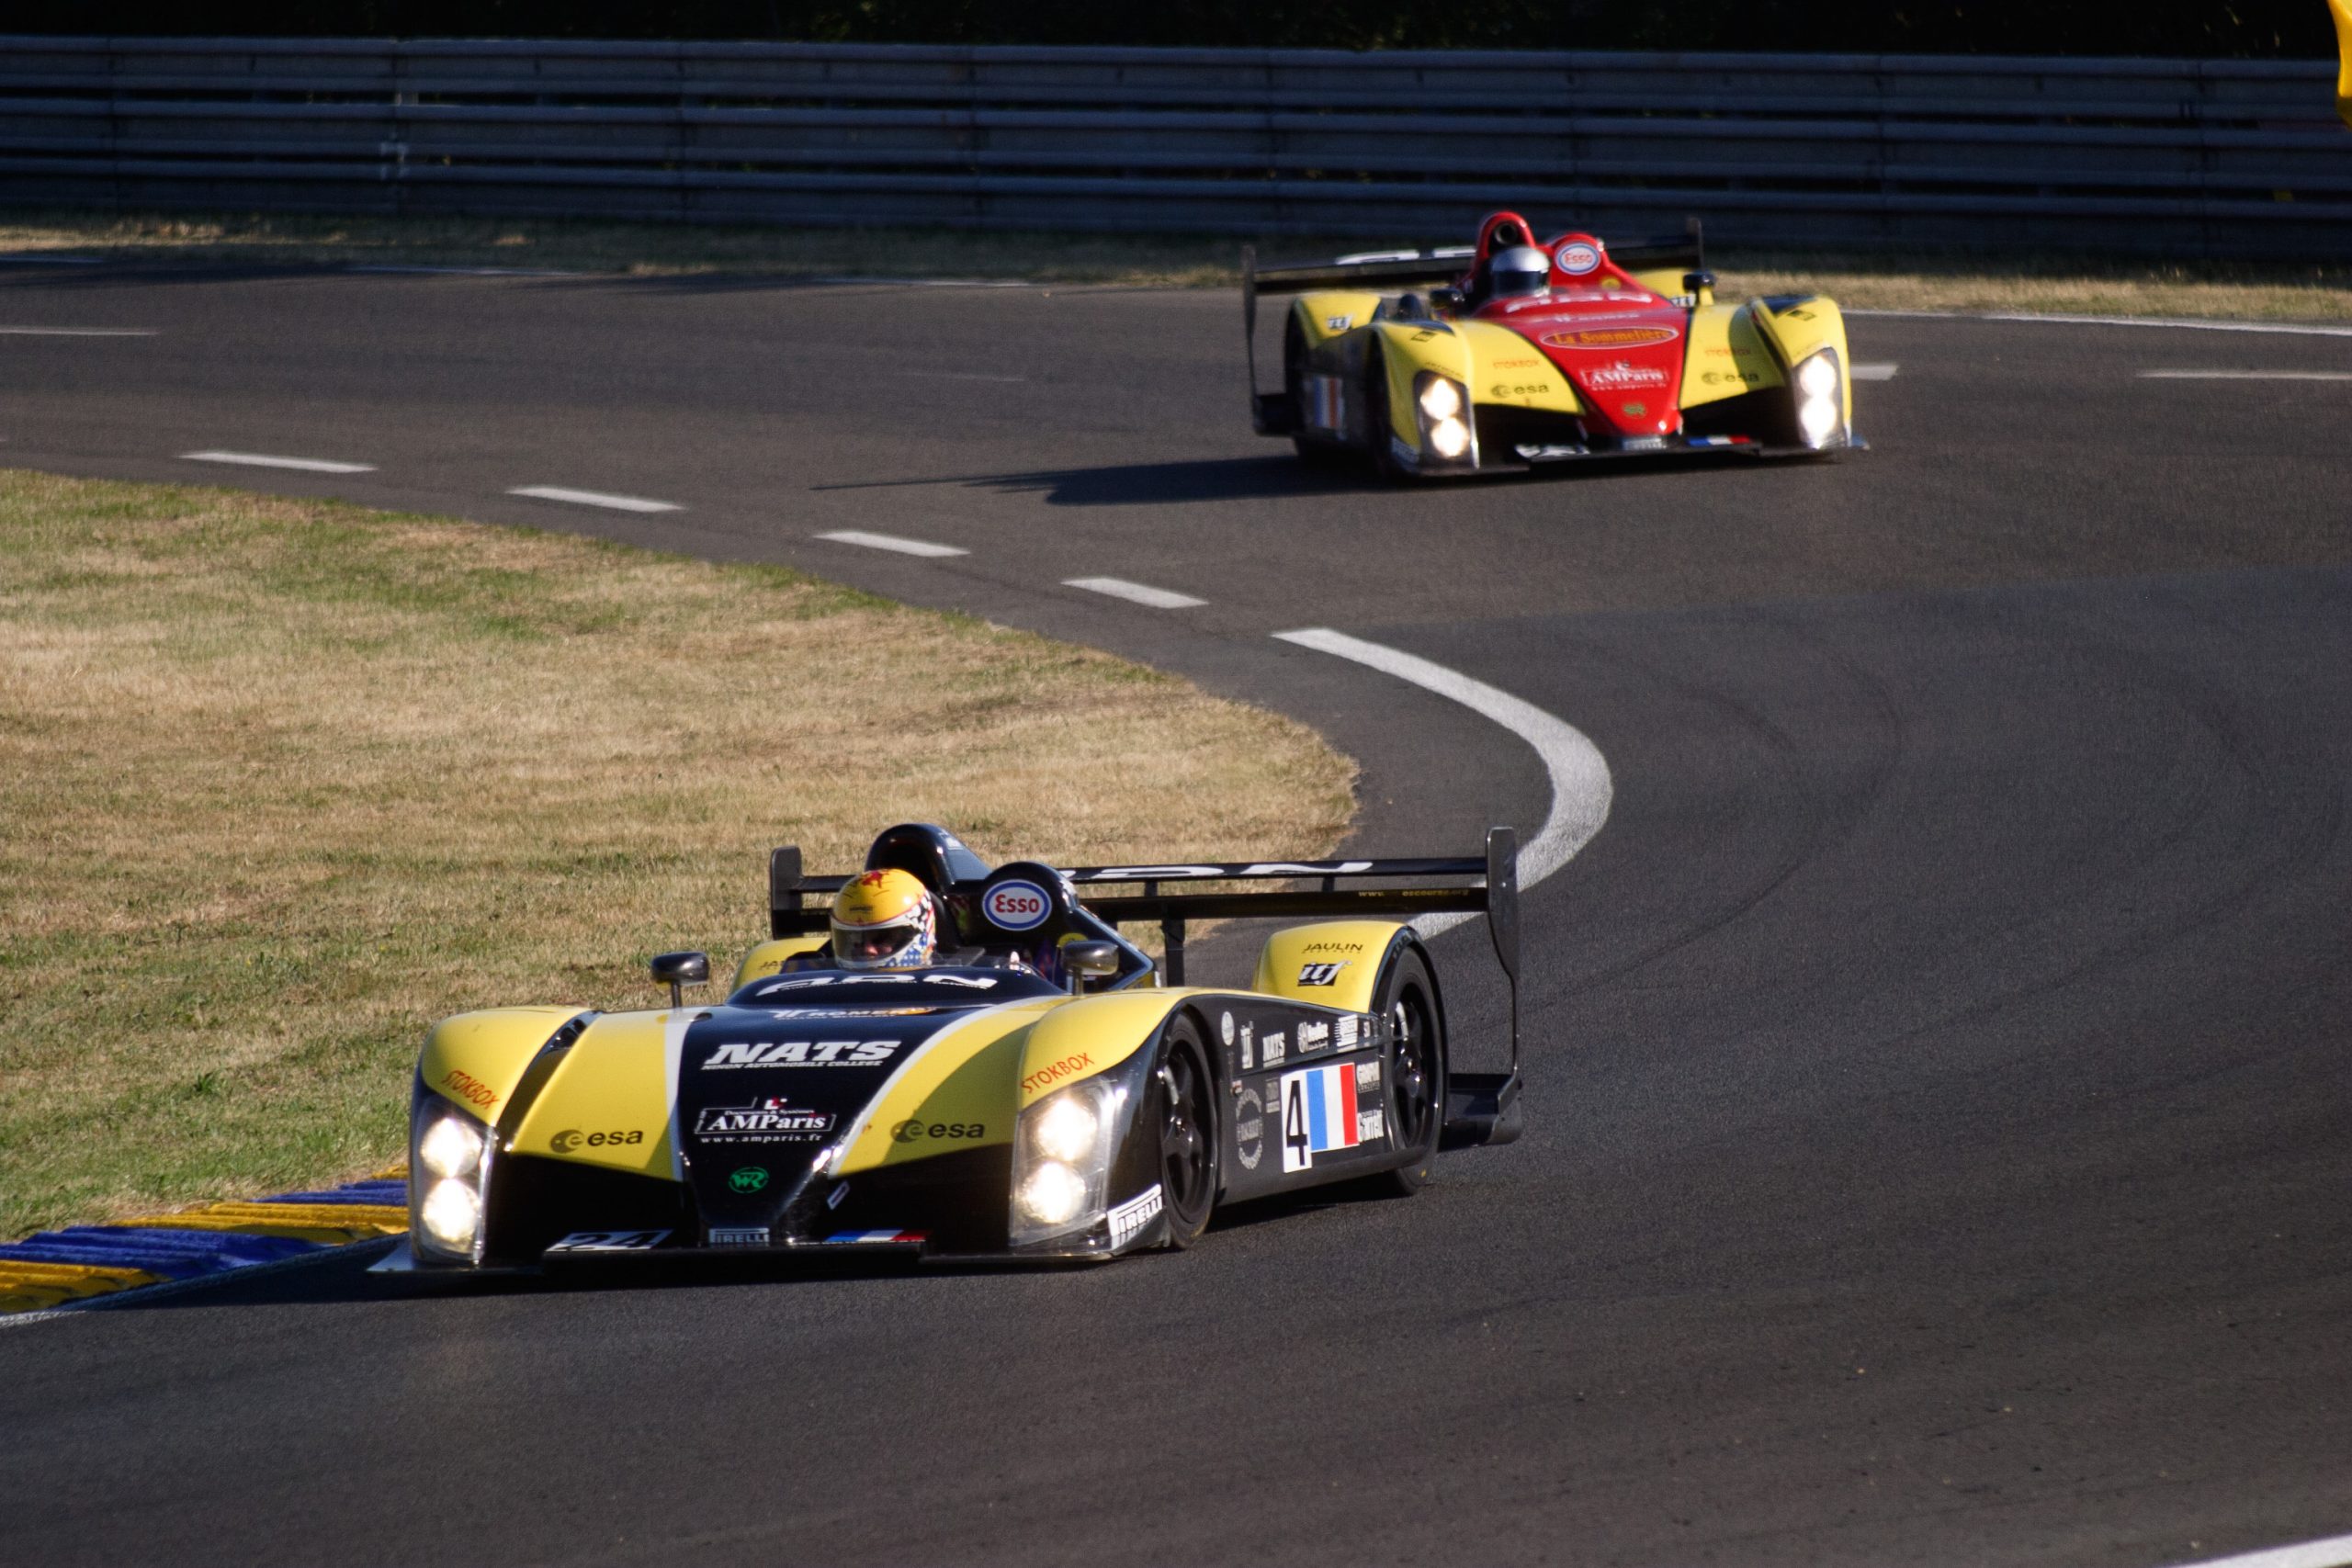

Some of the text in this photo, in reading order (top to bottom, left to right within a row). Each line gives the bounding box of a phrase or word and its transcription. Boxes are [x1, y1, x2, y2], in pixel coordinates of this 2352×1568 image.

[1564, 252, 1593, 265] Esso
[1514, 384, 1549, 395] esa
[994, 893, 1040, 914] Esso
[1304, 942, 1363, 952] JAULIN
[704, 1040, 902, 1065] NATS
[1021, 1052, 1095, 1094] STOKBOX
[441, 1069, 500, 1111] STOKBOX
[707, 1114, 827, 1131] AMParis
[928, 1120, 986, 1139] esa
[1286, 1079, 1308, 1167] 4
[588, 1130, 643, 1146] esa
[700, 1134, 823, 1145] www.amparis.fr
[1106, 1183, 1163, 1236] PIRELLI
[553, 1231, 663, 1250] 24
[708, 1227, 770, 1244] PIRELLI
